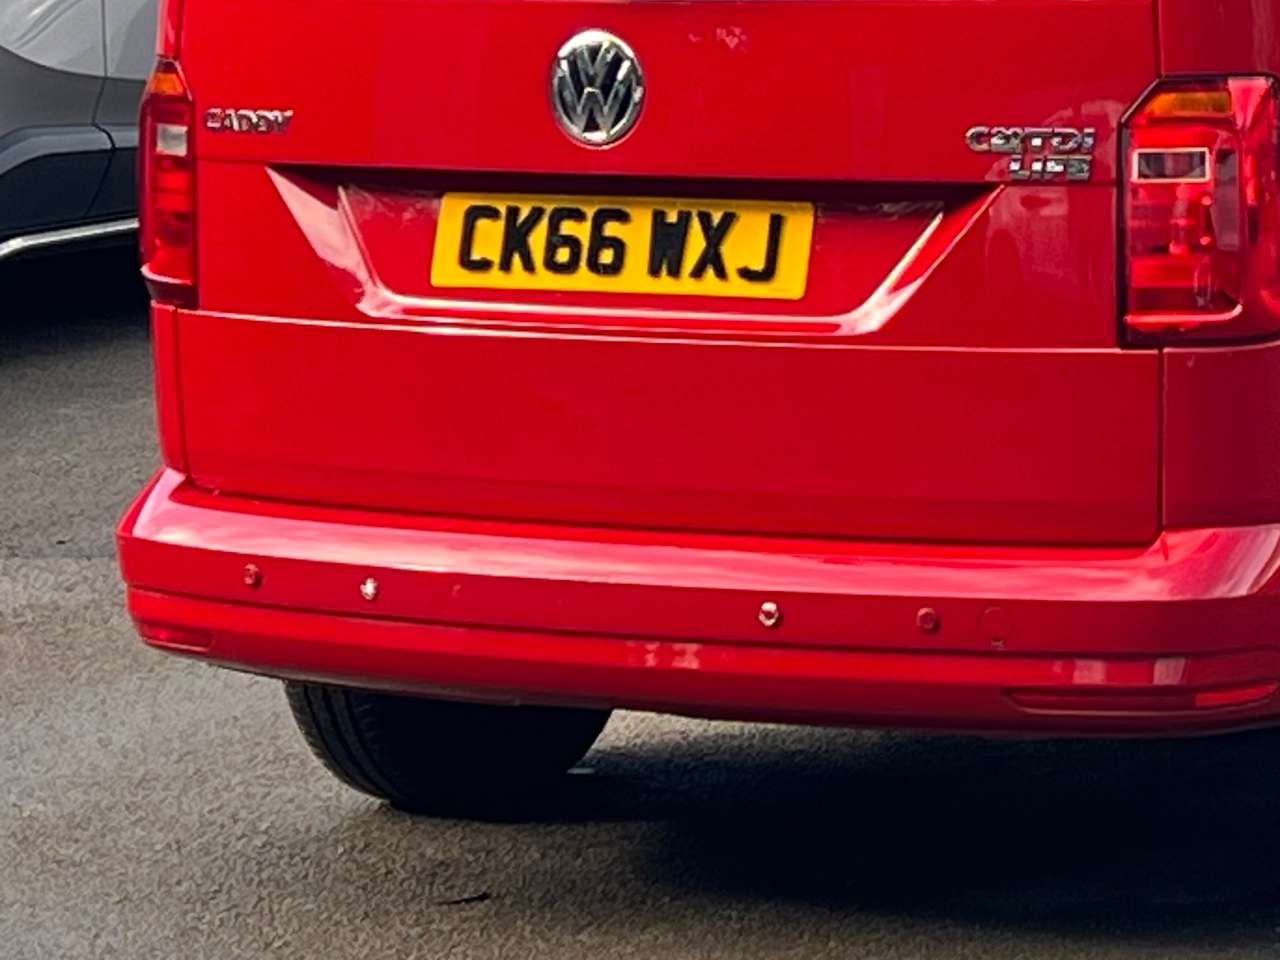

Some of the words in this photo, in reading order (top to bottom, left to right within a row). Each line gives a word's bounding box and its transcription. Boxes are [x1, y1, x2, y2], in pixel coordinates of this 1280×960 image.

[554, 28, 642, 148] VW
[460, 204, 630, 276] CK66
[647, 208, 786, 283] WXJ
